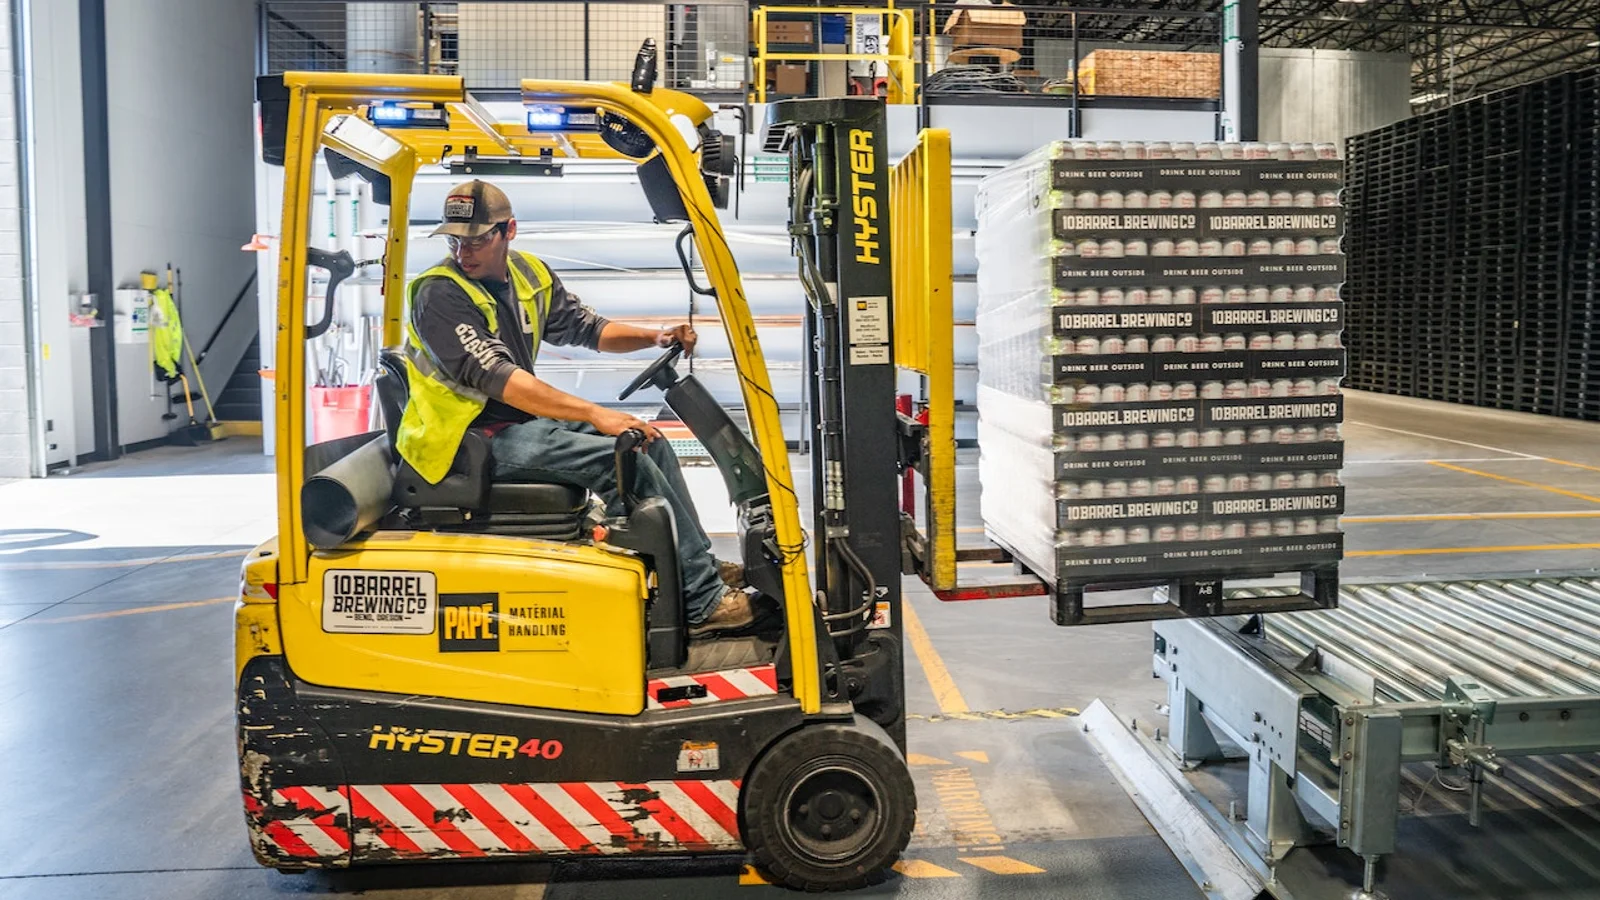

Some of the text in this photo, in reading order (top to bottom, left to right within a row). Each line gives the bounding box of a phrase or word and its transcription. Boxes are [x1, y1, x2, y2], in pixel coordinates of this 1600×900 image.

[849, 128, 880, 265] HYSTER
[1210, 454, 1242, 462] OUTSIDE
[1210, 548, 1242, 556] OUTSIDE
[1114, 556, 1147, 564] OUTSIDE
[509, 624, 565, 636] HANDLING
[368, 725, 563, 759] HYSTER 40
[929, 767, 1005, 852] WARNING!
